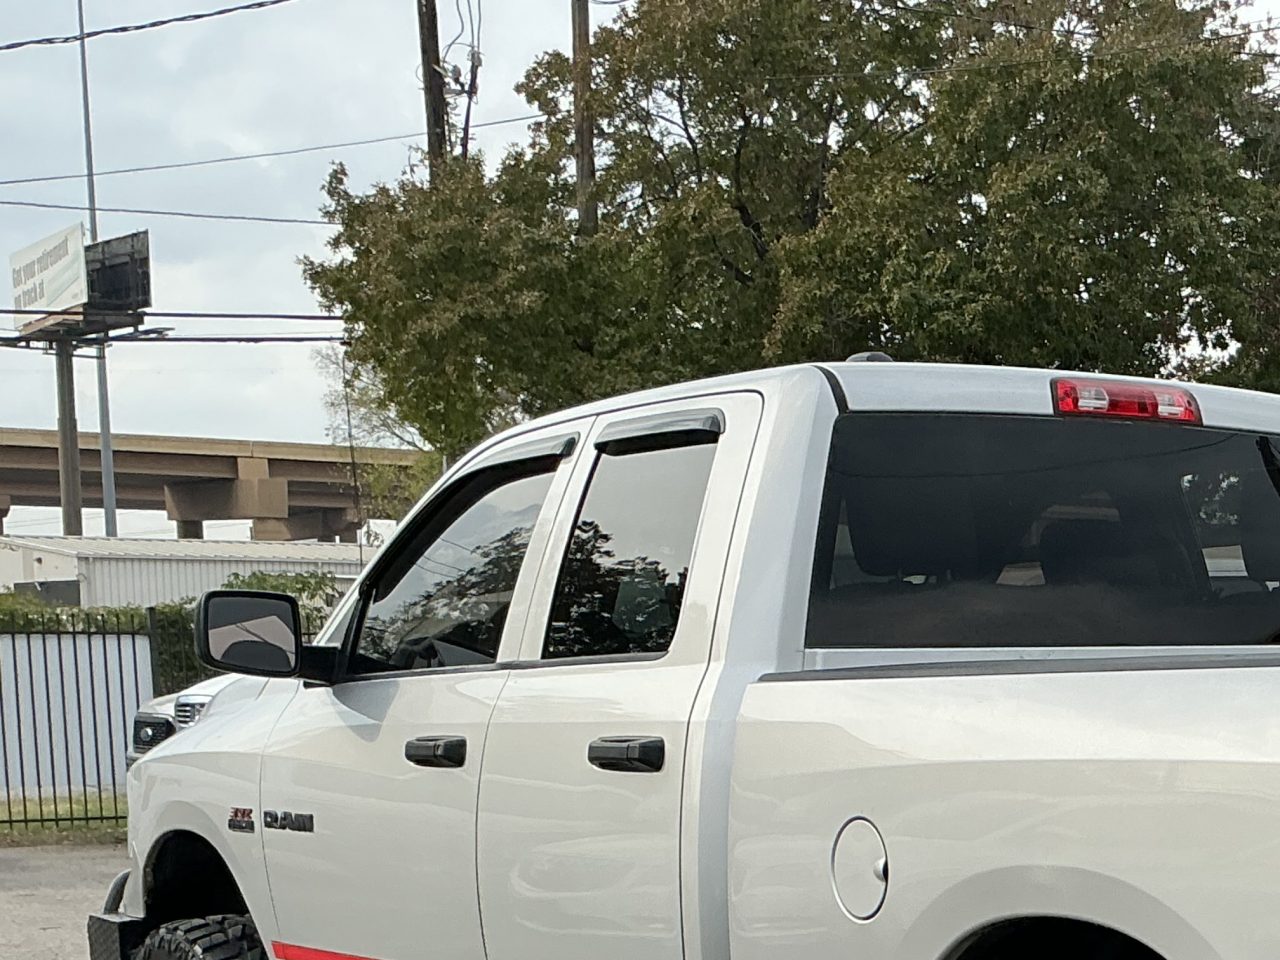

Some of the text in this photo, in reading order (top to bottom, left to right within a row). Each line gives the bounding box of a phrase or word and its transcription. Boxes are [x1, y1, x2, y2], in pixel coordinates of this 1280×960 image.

[22, 259, 37, 285] your
[36, 235, 69, 275] retirement
[22, 281, 39, 308] track
[263, 809, 314, 832] RAM
